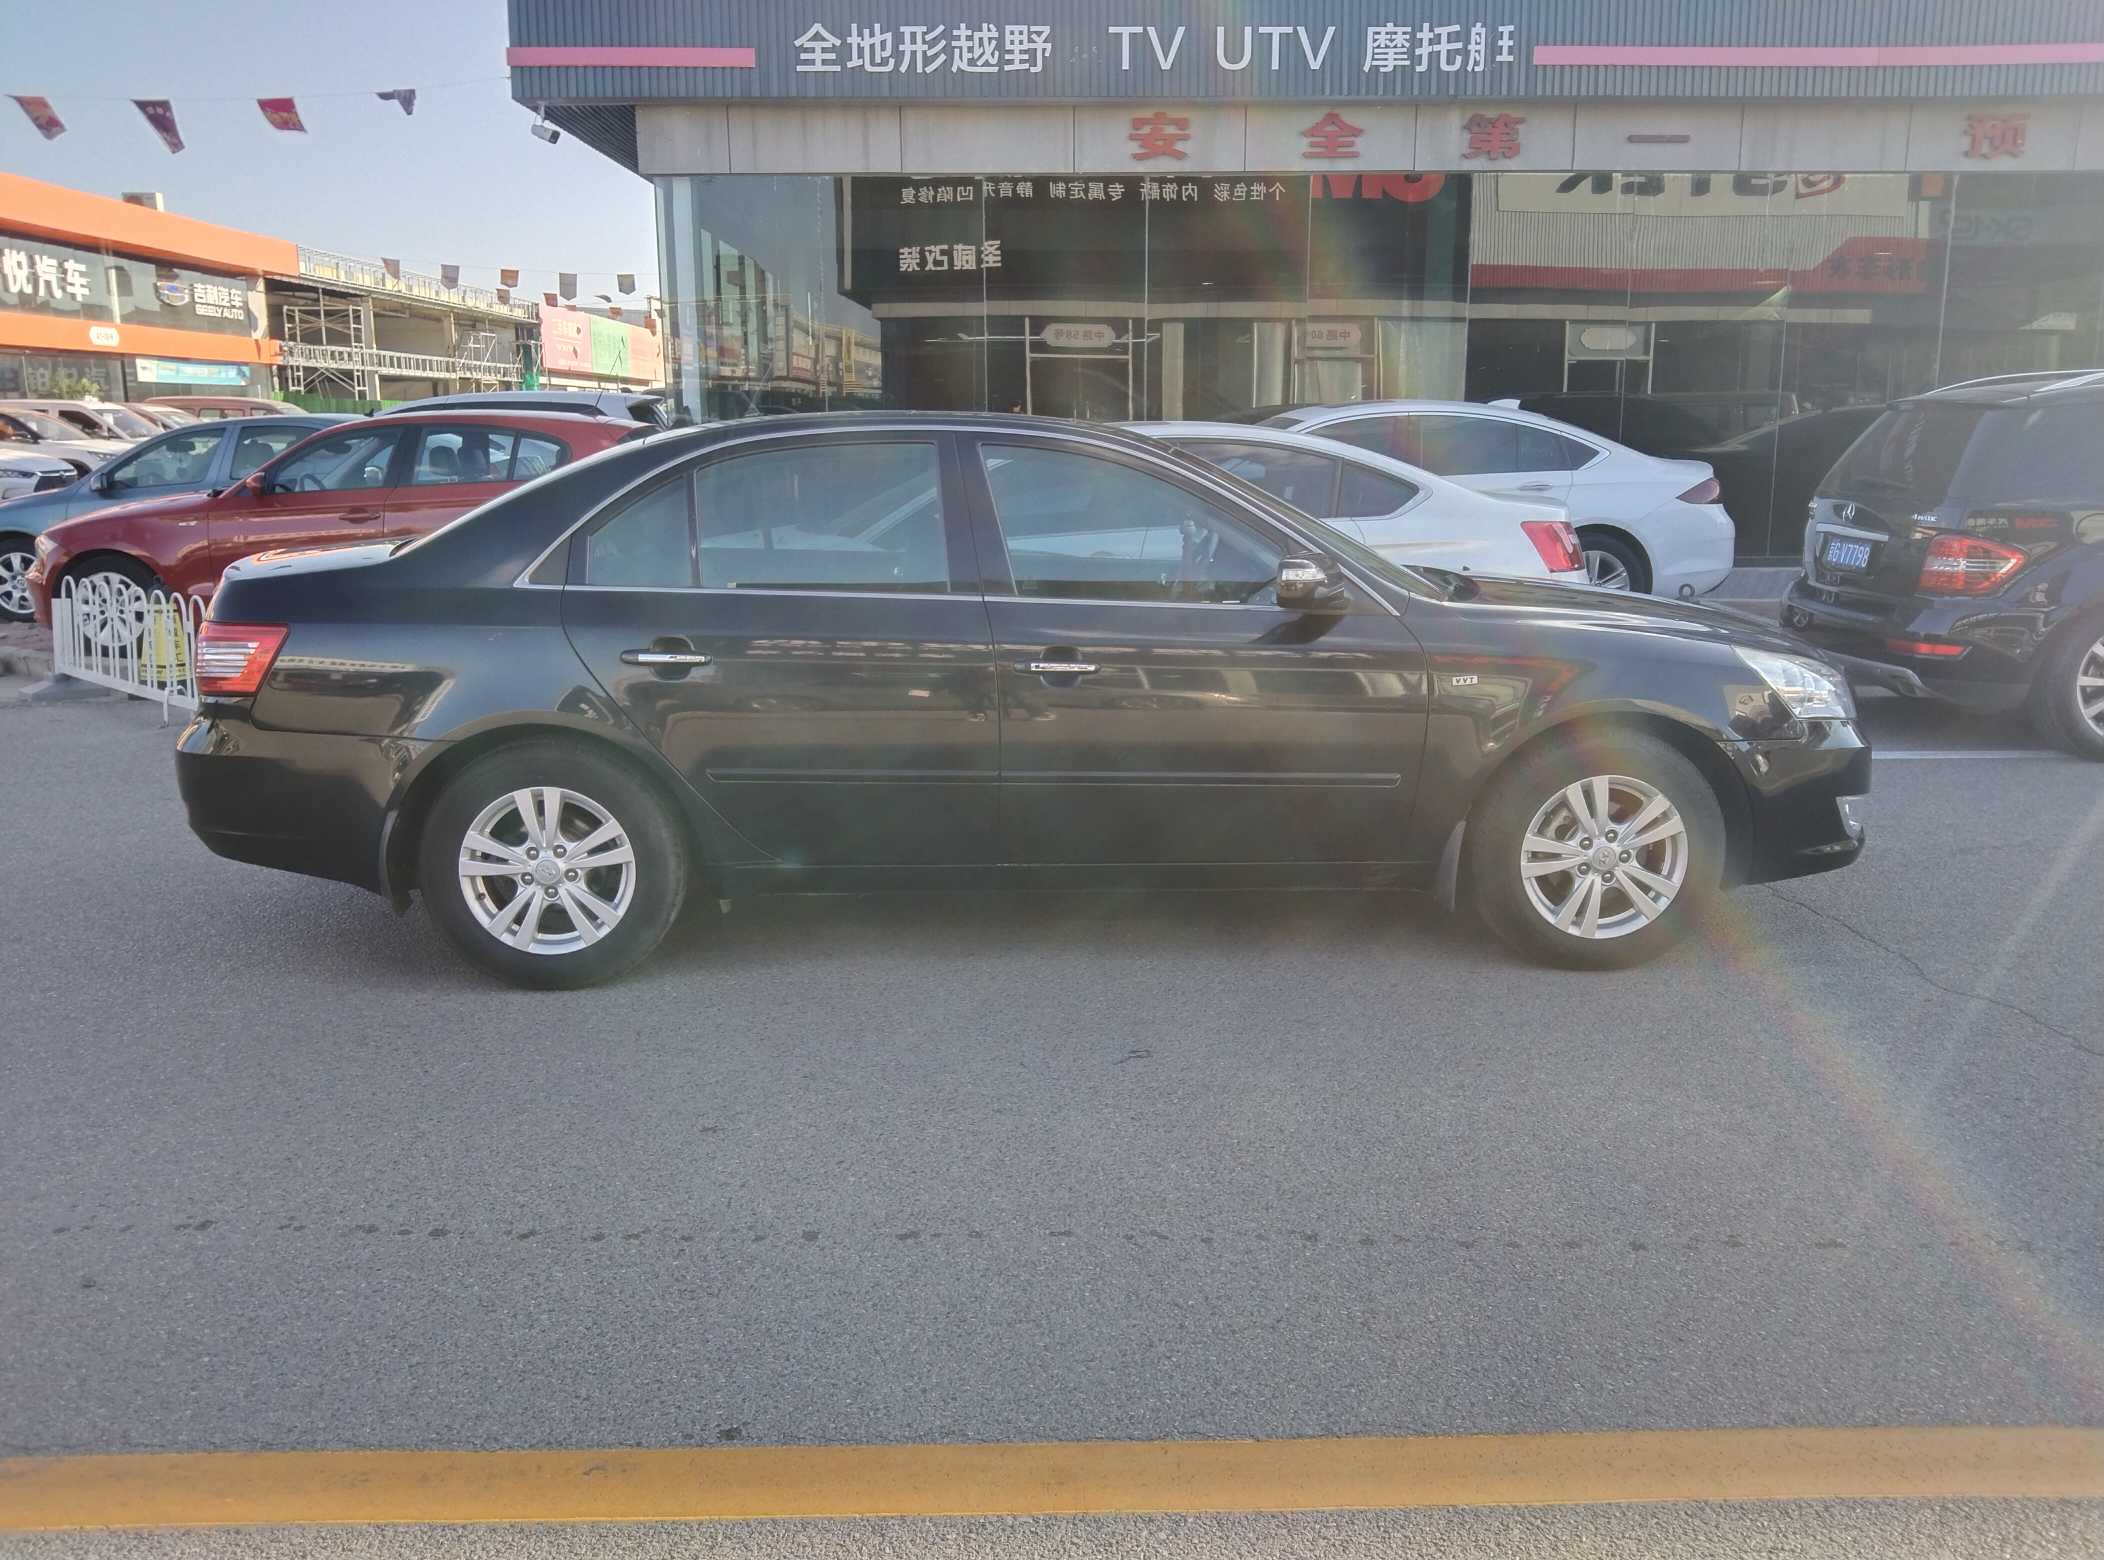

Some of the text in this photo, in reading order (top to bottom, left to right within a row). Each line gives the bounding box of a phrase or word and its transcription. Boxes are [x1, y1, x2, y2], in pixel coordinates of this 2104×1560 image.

[794, 22, 1052, 74] 全地形越野
[1108, 25, 1187, 71] TV
[1215, 25, 1337, 71] UTV
[193, 283, 244, 308] 吉利汽车
